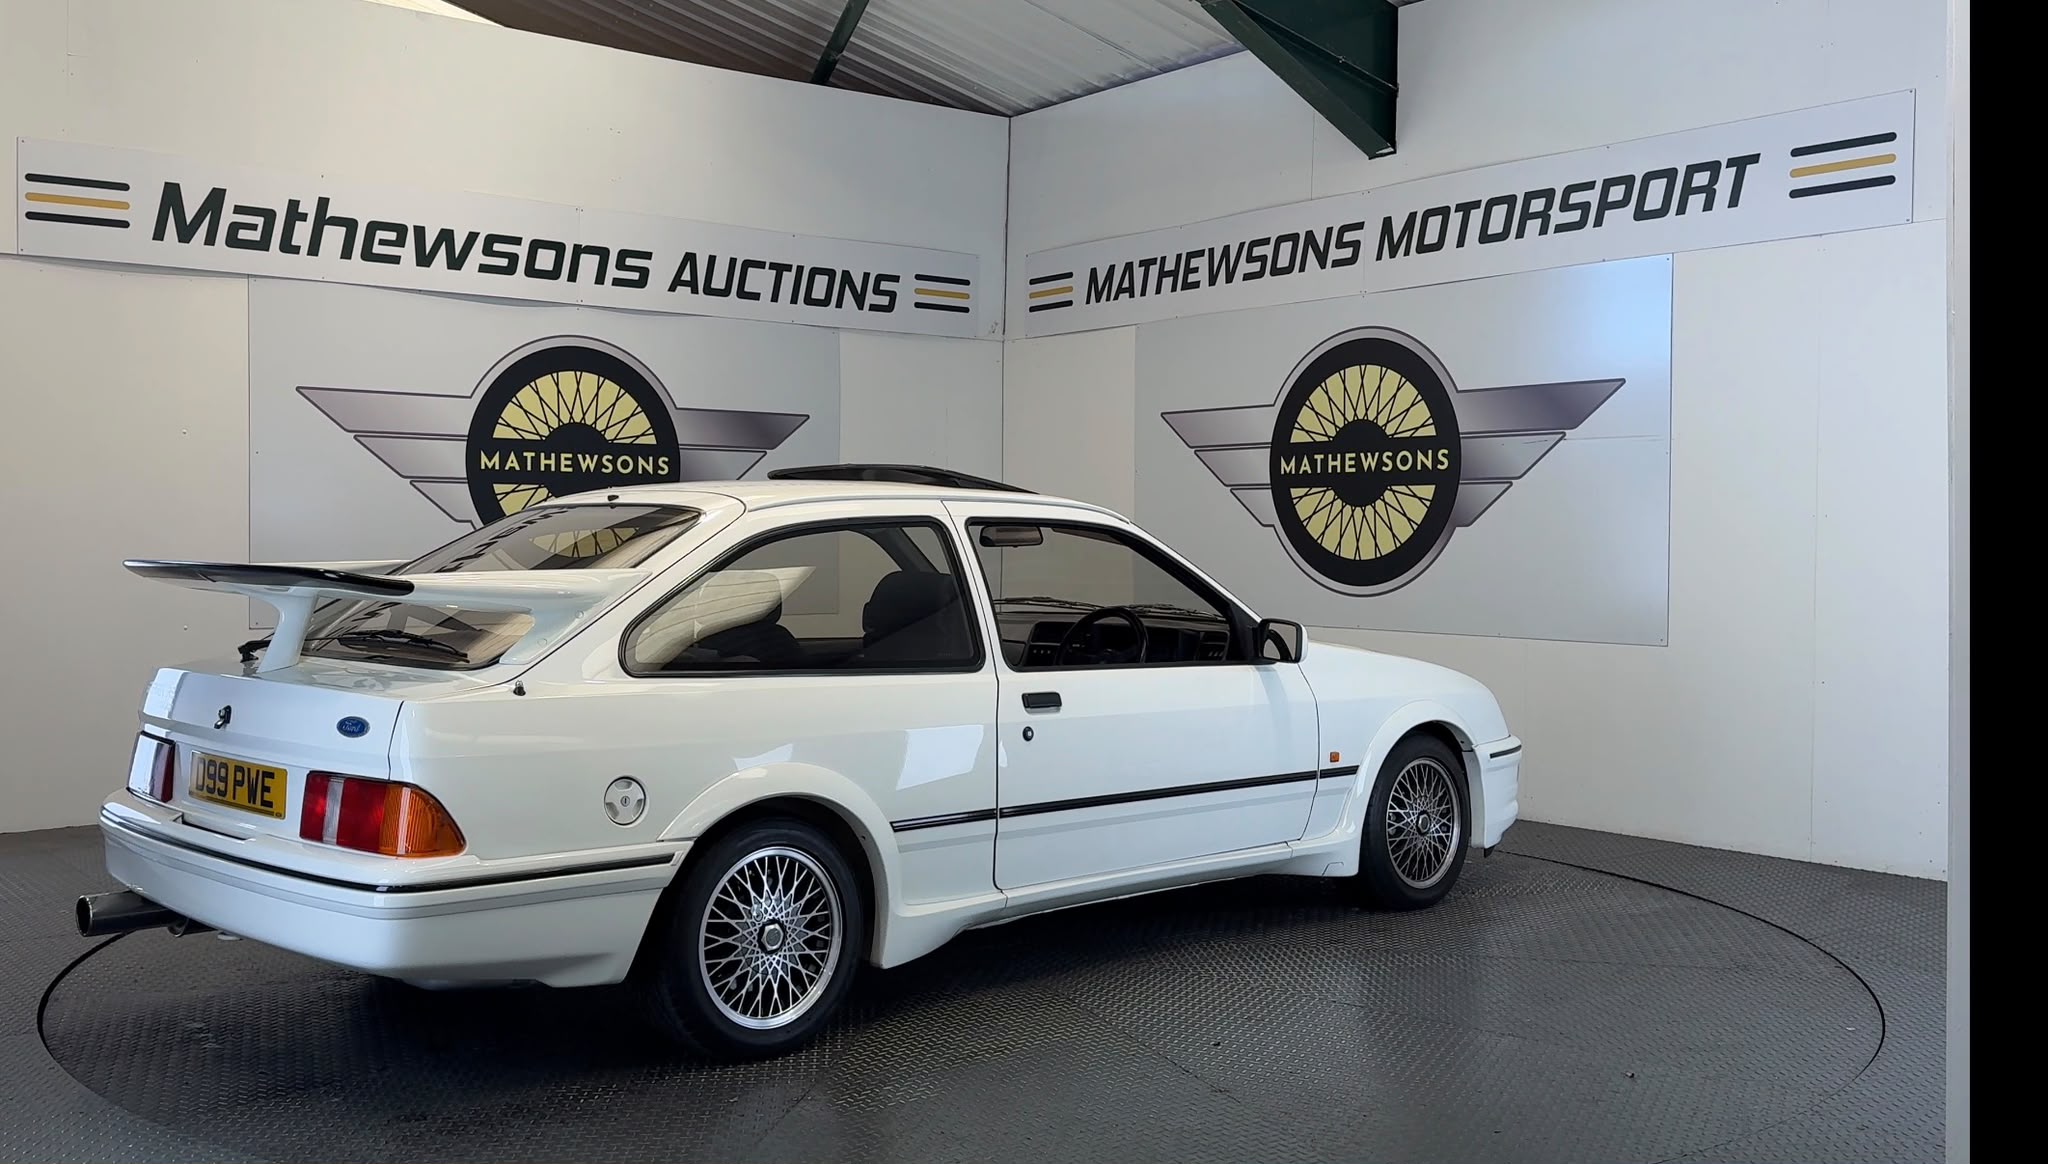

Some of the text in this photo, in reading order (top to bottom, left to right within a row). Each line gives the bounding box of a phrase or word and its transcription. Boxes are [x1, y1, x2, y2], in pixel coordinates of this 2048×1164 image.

[151, 181, 901, 314] Mathewsons AUCTIONS
[1085, 152, 1761, 305] MATHEWSONS MOTORSPORT
[480, 450, 670, 476] MATHEWSONS
[1280, 448, 1449, 475] MATHEWSONS
[195, 757, 275, 808] D99 PWE
